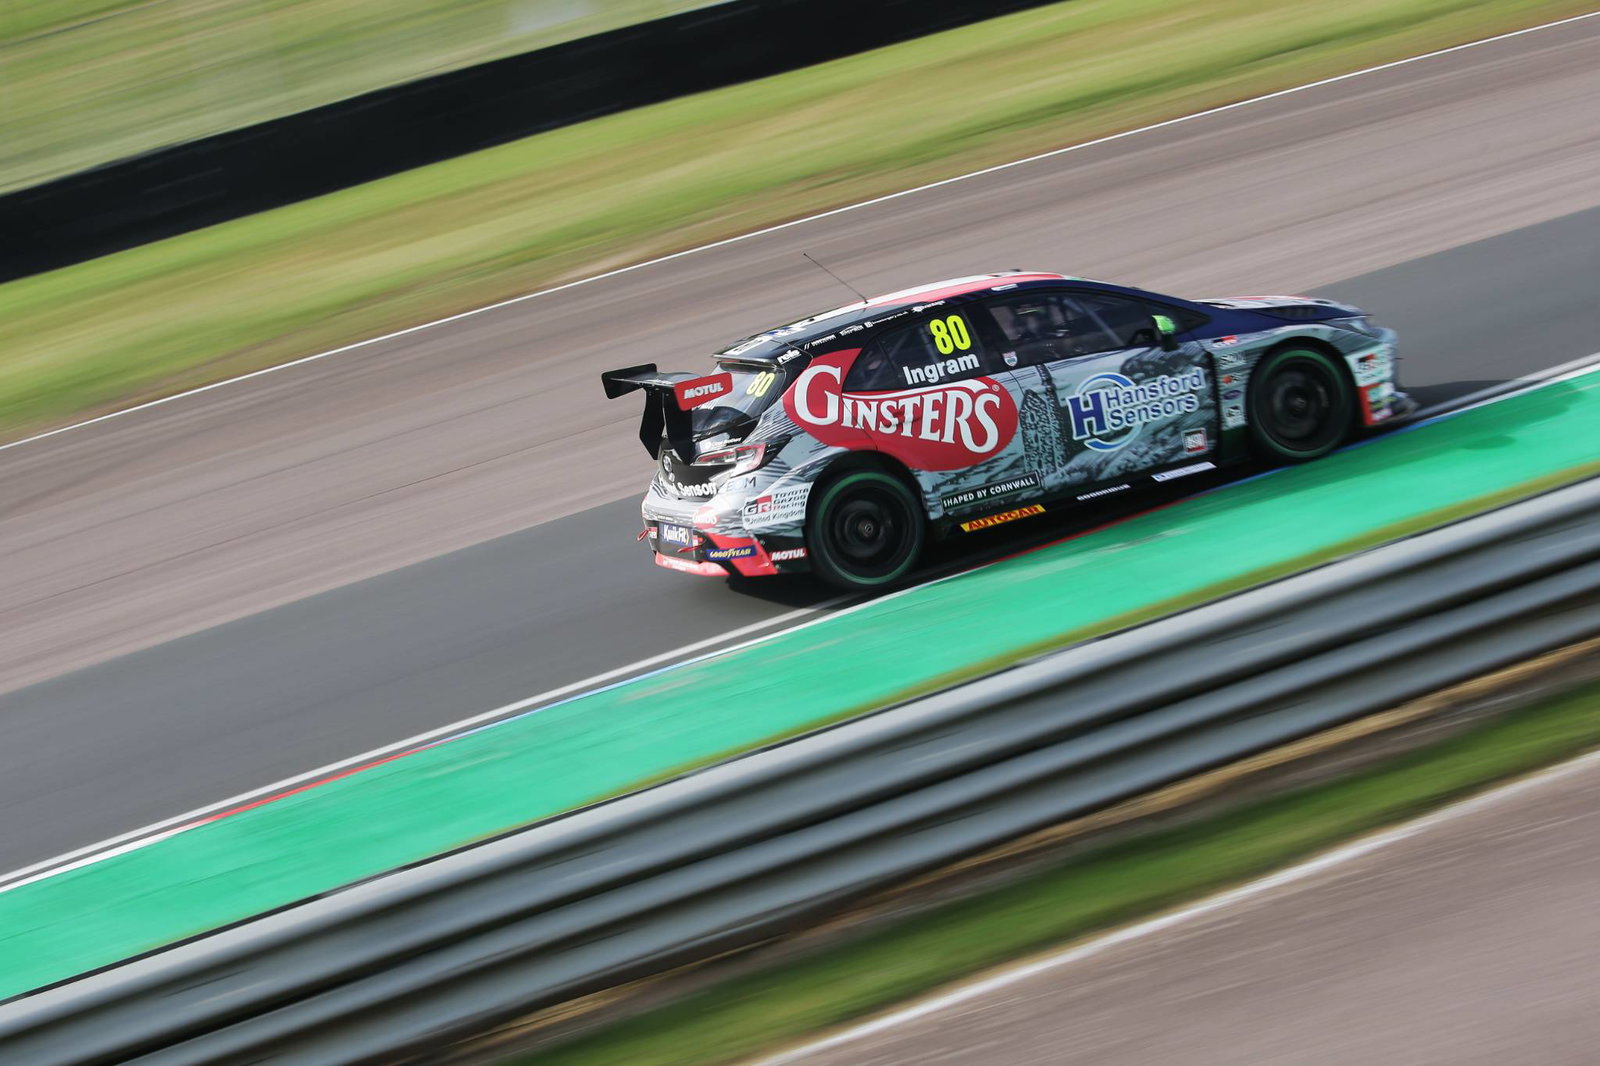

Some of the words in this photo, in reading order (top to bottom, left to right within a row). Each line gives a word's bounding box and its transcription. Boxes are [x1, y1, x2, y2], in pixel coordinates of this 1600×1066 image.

[929, 315, 972, 355] 80
[902, 353, 980, 385] Ingram
[684, 382, 724, 399] MOTUL
[746, 371, 776, 397] 80
[1103, 367, 1206, 409] Hansford
[794, 364, 1001, 453] GINSTERS
[1108, 393, 1201, 433] Sensors
[976, 489, 987, 499] BY
[989, 477, 1036, 495] CORNWALL
[968, 506, 1041, 531] AUTOCAR
[709, 547, 751, 559] GOODYEAR
[771, 549, 805, 561] MOTUL
